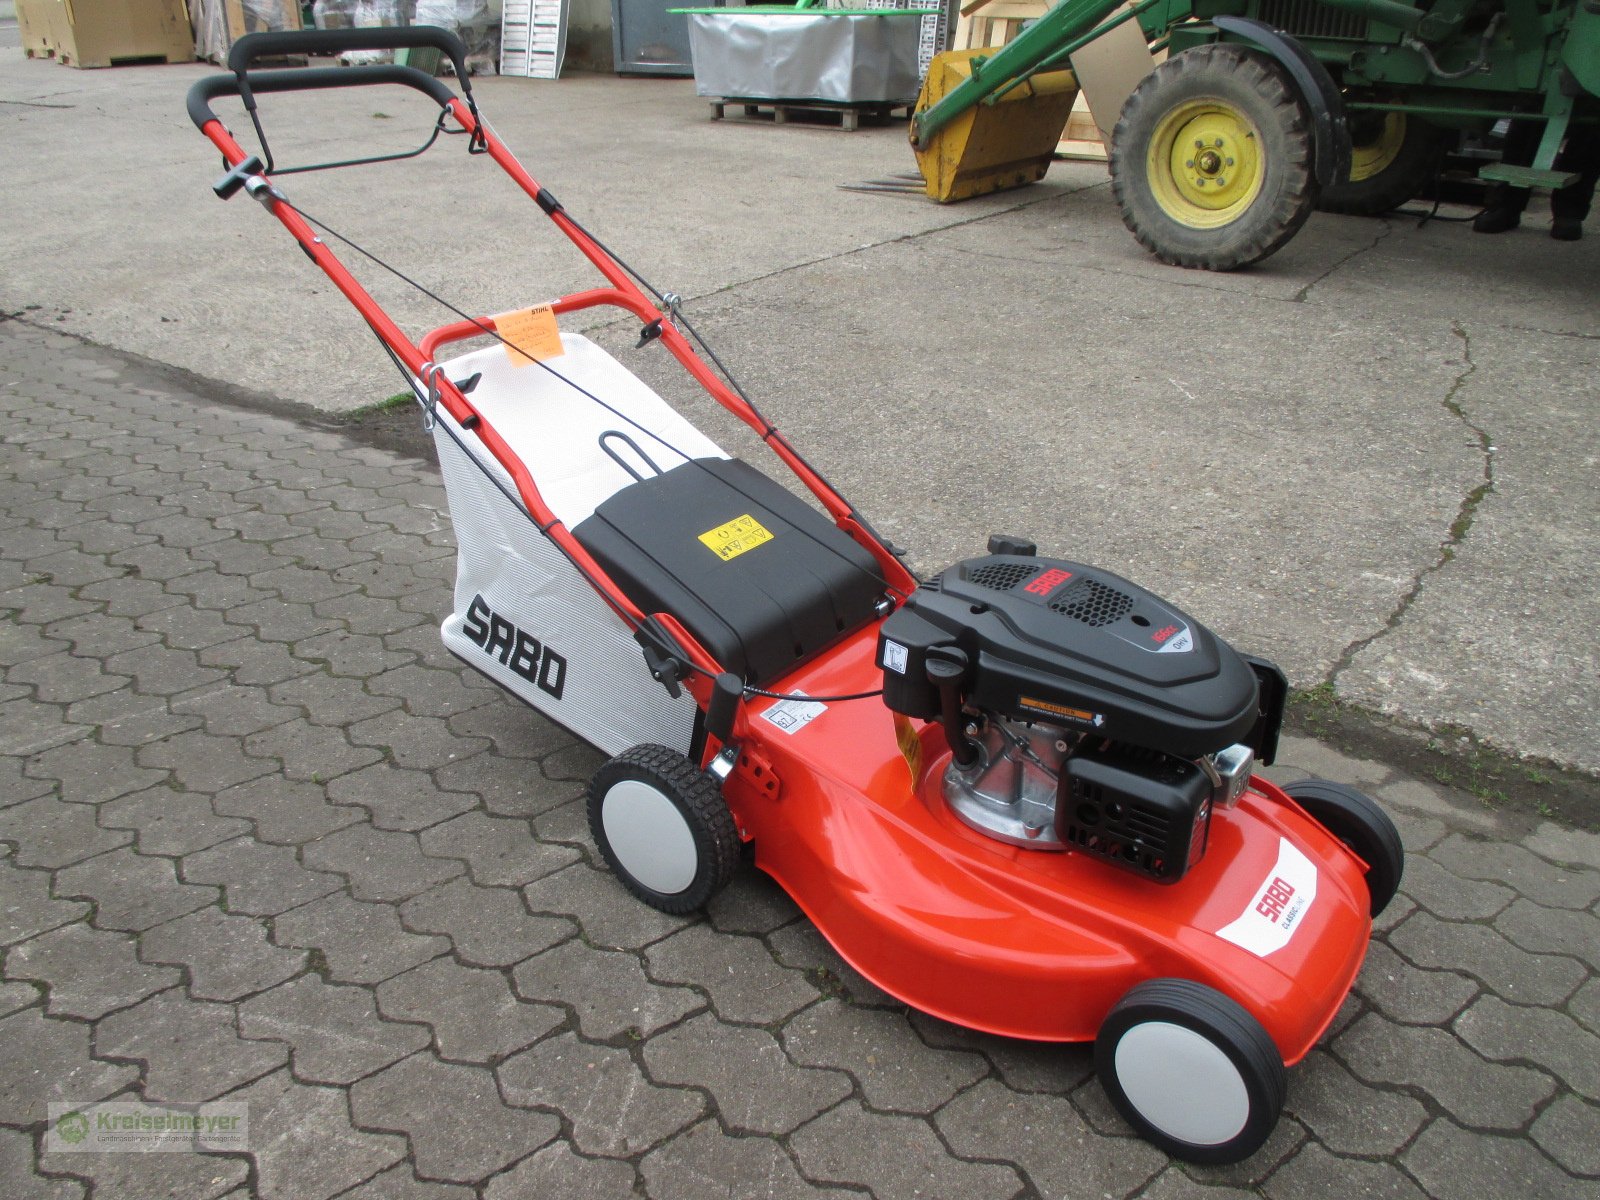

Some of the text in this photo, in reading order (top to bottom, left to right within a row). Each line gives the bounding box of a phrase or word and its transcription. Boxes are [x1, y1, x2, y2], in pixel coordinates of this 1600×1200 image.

[531, 306, 549, 315] STIHL
[1024, 568, 1072, 596] SABO
[463, 593, 567, 700] SABO
[1172, 636, 1189, 650] OHV
[1256, 877, 1295, 923] SABO
